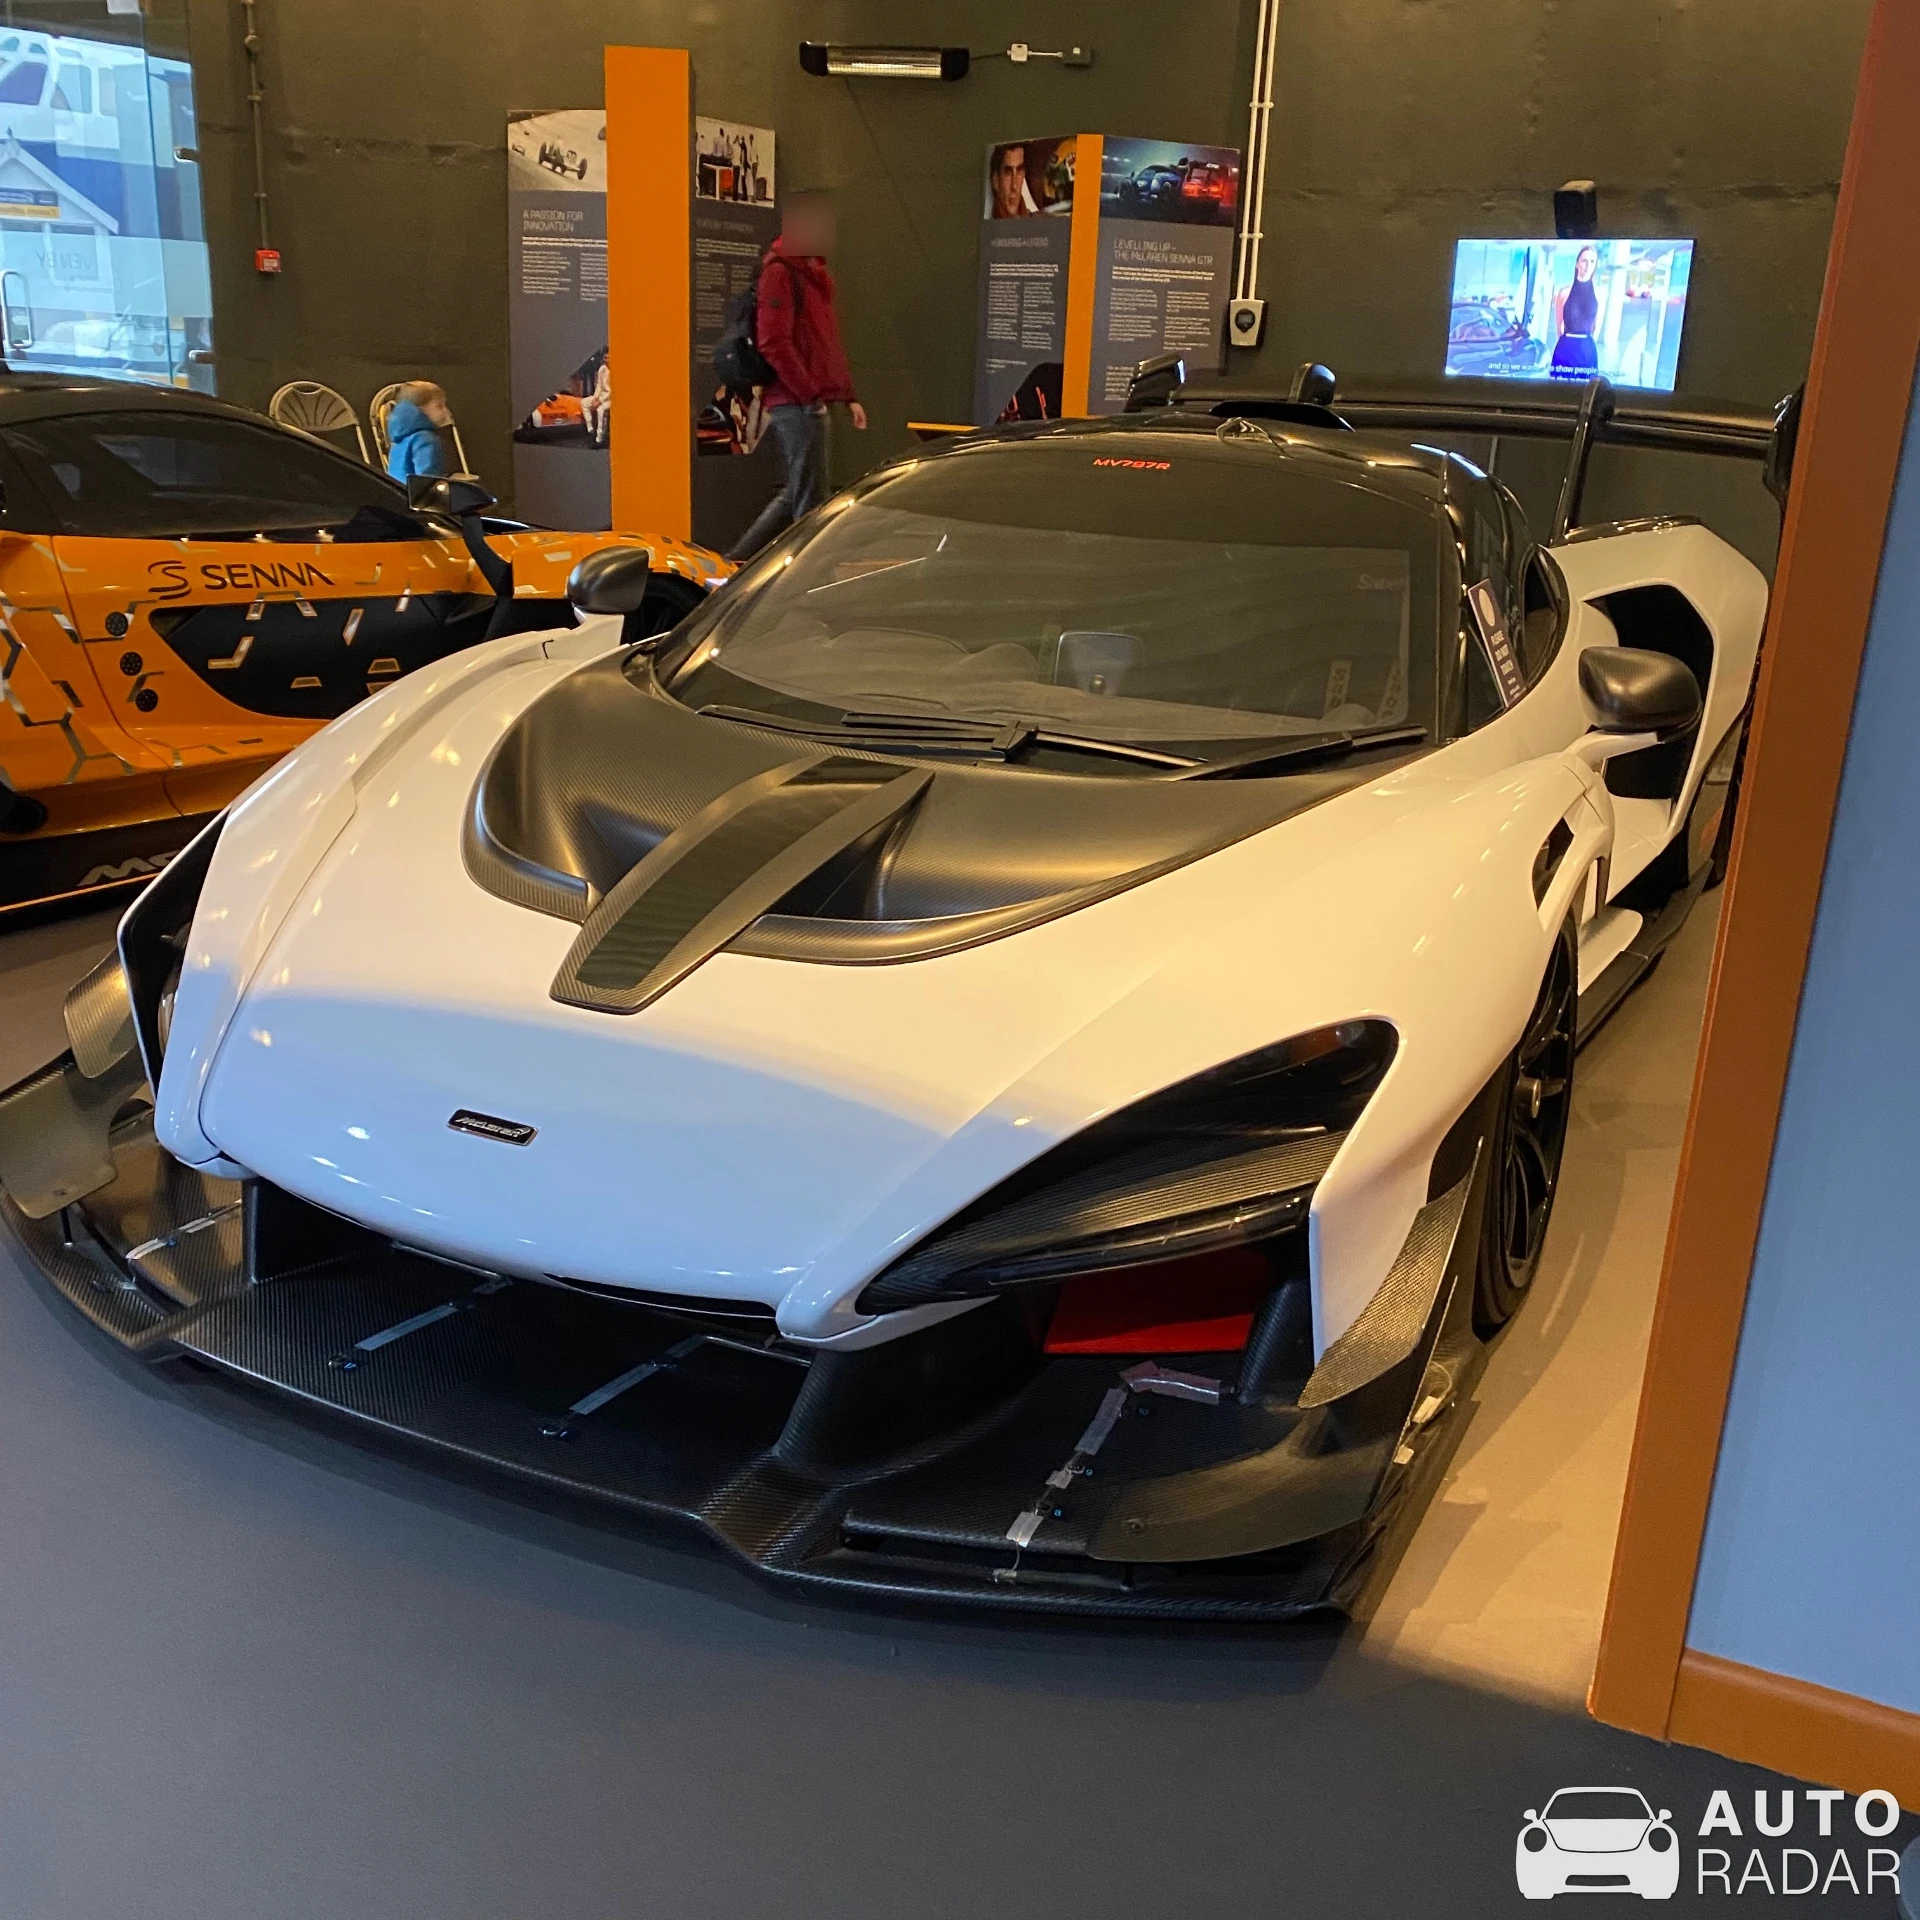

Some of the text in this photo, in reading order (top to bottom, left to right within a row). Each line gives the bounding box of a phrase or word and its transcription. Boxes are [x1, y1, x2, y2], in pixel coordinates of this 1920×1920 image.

[523, 210, 583, 221] A PASSION FOR
[523, 221, 574, 232] INNOVATION
[1114, 239, 1158, 251] LEVELLING
[1114, 250, 1128, 260] THE
[1169, 253, 1196, 264] SENNA
[1197, 255, 1213, 265] GTR
[1555, 365, 1573, 373] show
[201, 562, 335, 590] SENNA
[1490, 630, 1504, 646] PLEASE
[1500, 659, 1514, 676] TOUCH
